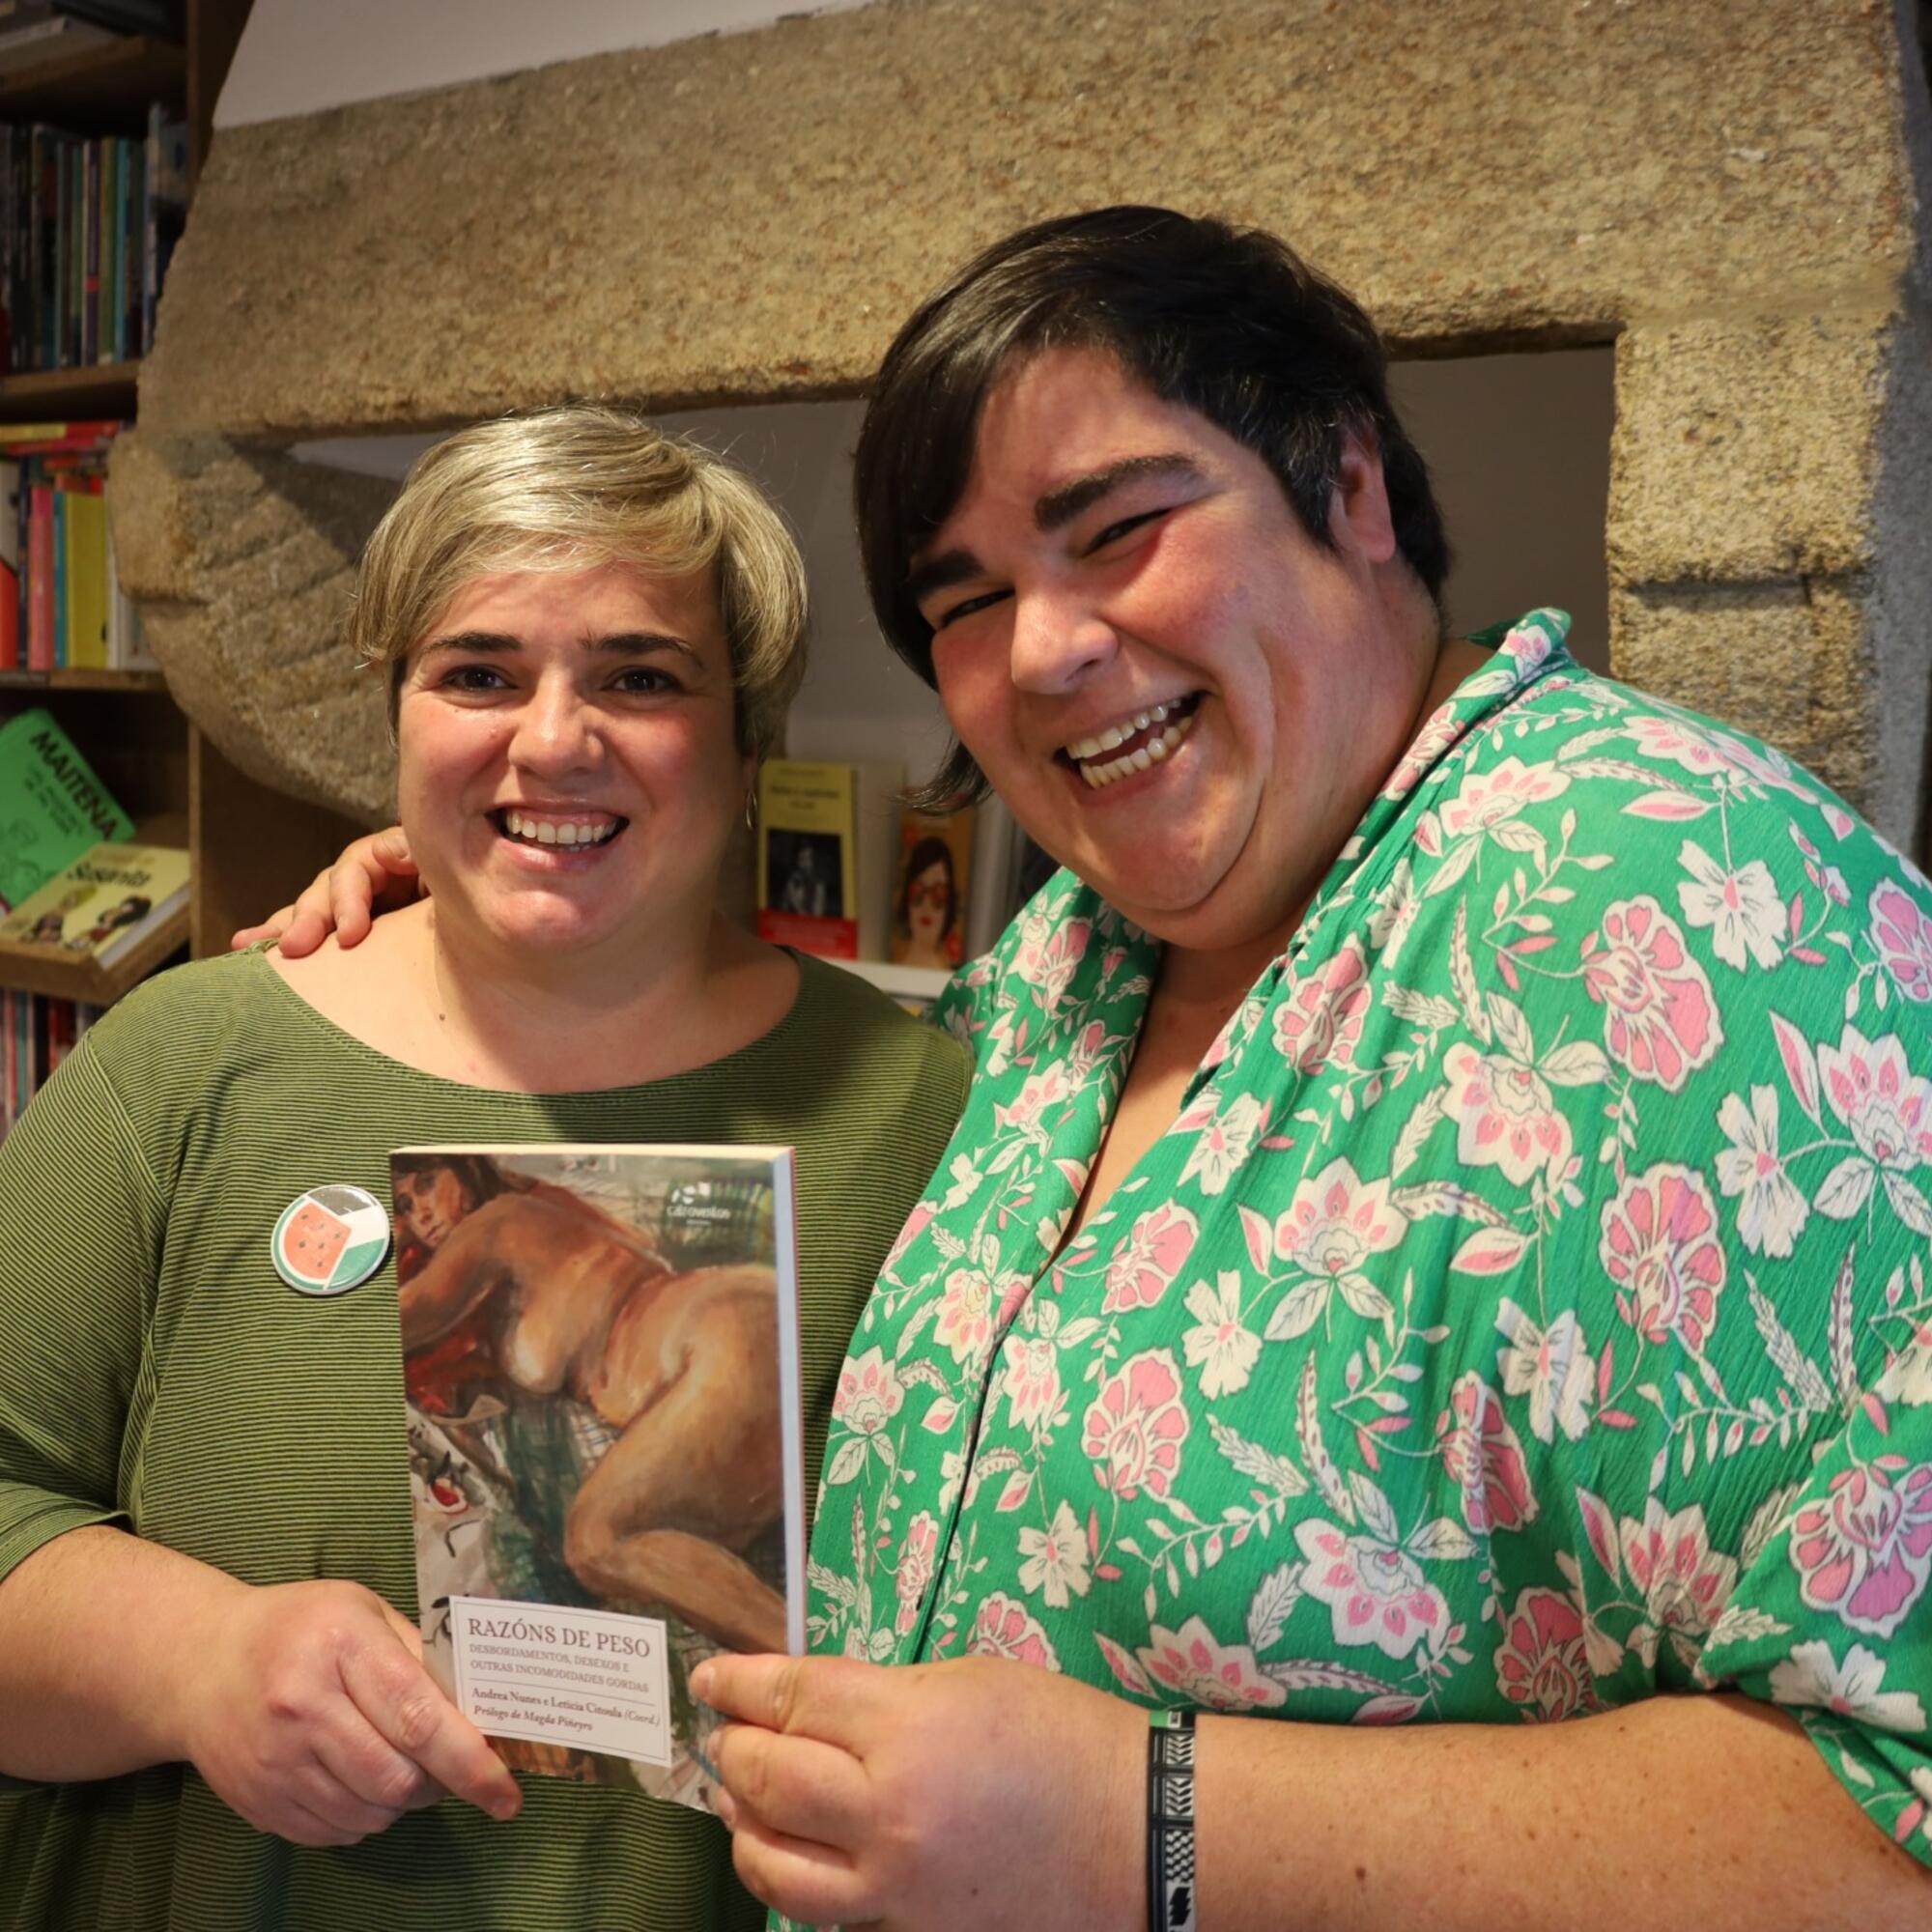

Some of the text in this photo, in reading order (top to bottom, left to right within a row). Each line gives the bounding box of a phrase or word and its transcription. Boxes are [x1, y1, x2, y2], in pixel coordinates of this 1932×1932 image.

[29, 730, 119, 841] MAITENA
[468, 1618, 650, 1658] RAZÓNS DE PESO
[469, 1644, 572, 1664] DESBORDAMENTOS,
[574, 1655, 621, 1672] DESEXOS
[470, 1660, 649, 1692] OUTRAS INCOMODIDADES GORDAS
[471, 1688, 508, 1700] Andrea
[510, 1690, 542, 1704] Nunes
[624, 1709, 661, 1727] (Coord.)
[474, 1705, 509, 1720] Prólogo
[510, 1709, 522, 1719] de
[524, 1711, 555, 1725] Magda
